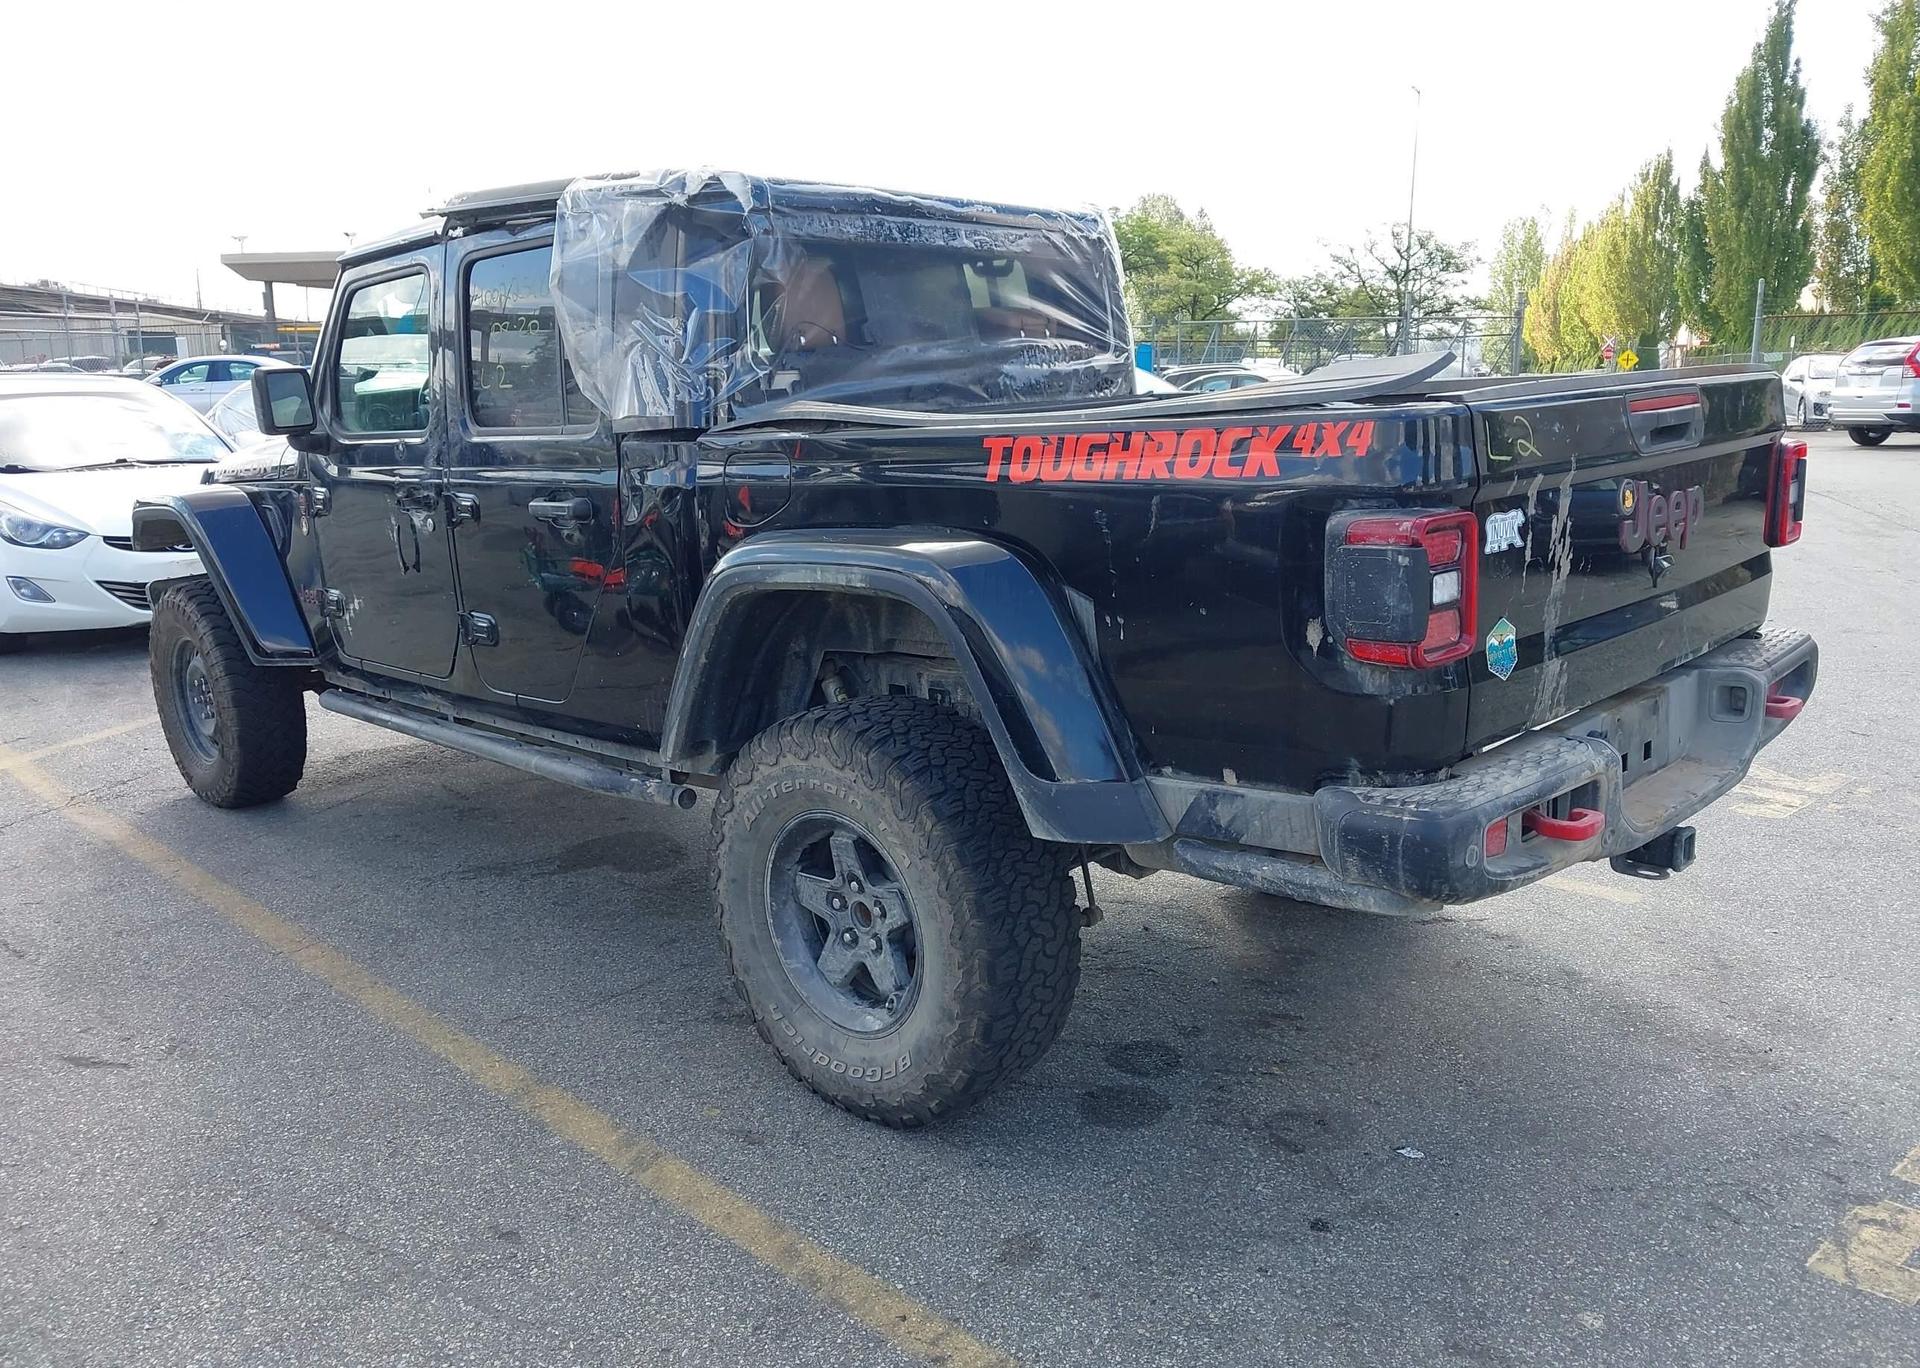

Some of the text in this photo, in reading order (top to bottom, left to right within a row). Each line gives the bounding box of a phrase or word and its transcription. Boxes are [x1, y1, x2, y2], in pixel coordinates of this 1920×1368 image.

[982, 424, 1294, 484] TOUGHROCK
[1619, 480, 1705, 554] Jeep
[768, 1003, 912, 1083] BFGoodrich
